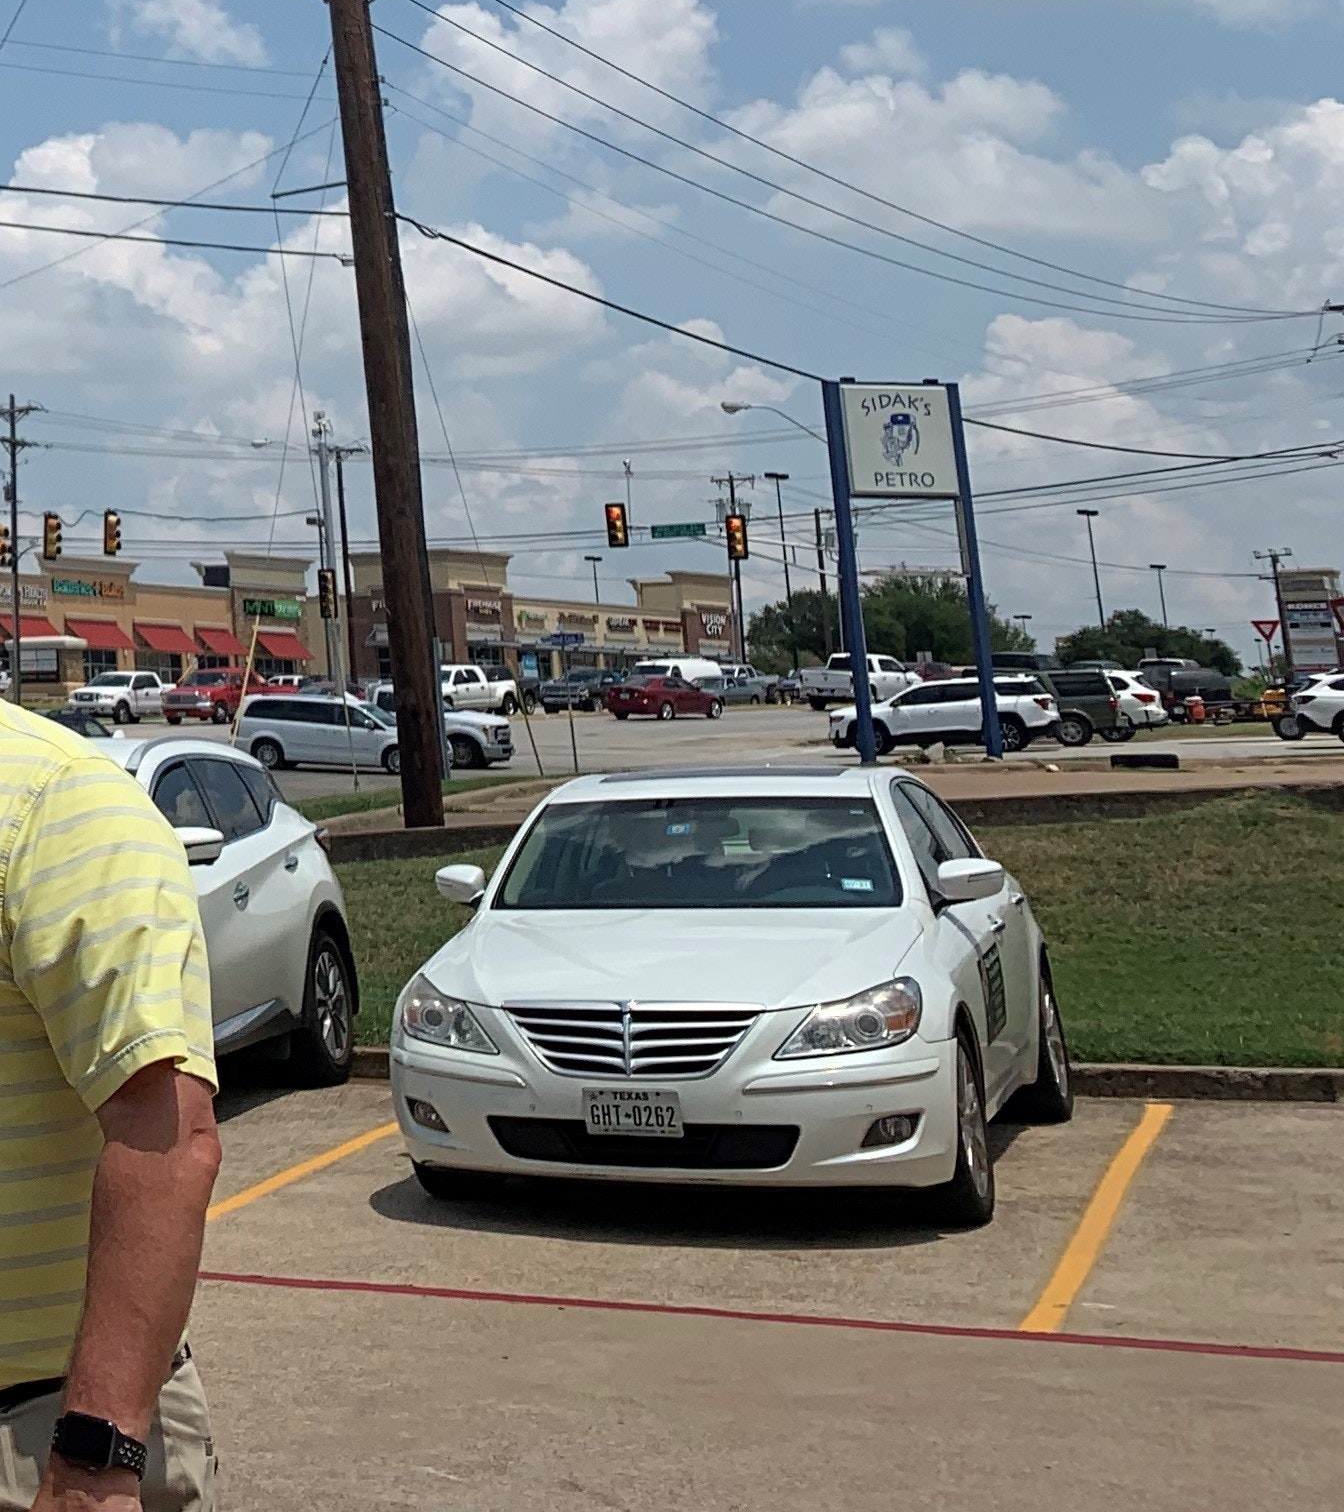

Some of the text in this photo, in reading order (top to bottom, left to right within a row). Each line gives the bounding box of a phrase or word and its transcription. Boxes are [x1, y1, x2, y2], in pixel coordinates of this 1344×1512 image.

[874, 471, 935, 488] PETRO
[701, 612, 727, 626] VISION
[706, 624, 723, 635] CITY
[612, 1091, 649, 1101] TEXAS
